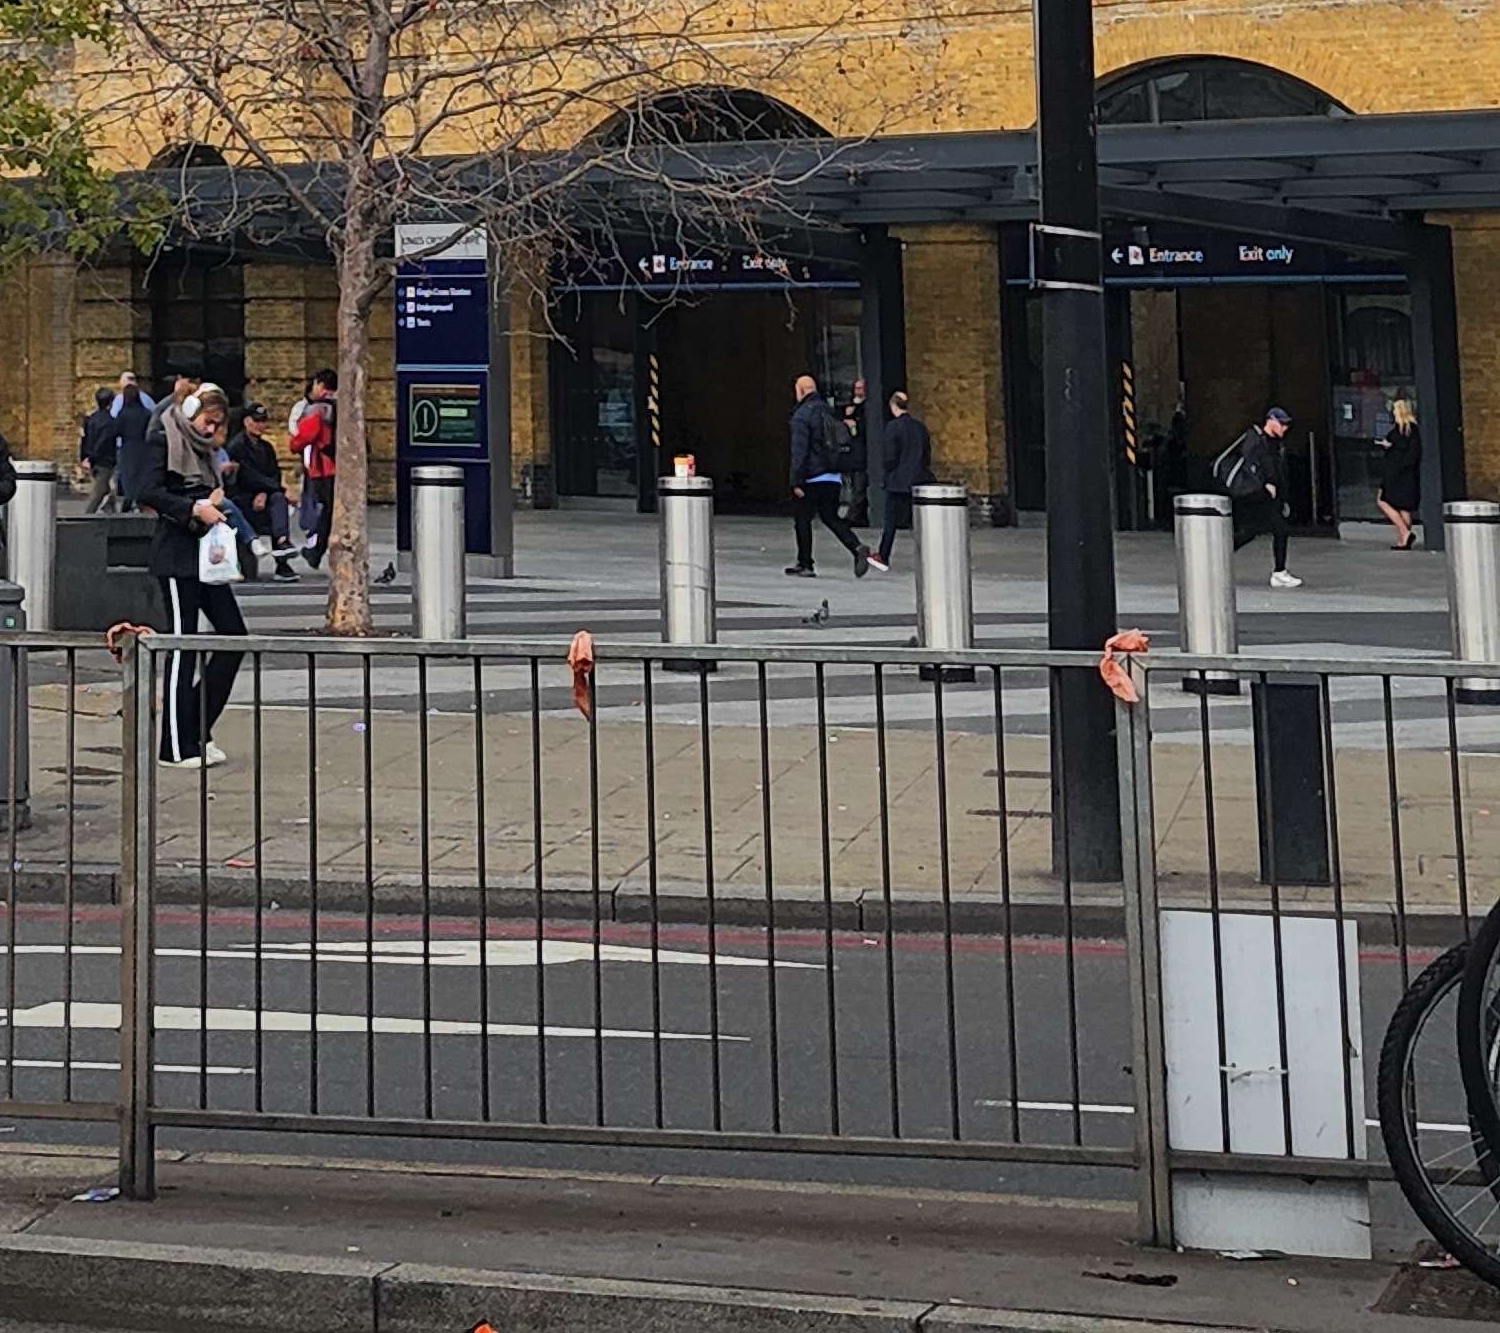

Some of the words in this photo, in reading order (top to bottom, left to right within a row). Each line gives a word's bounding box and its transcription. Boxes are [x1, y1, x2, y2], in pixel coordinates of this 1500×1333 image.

[1149, 247, 1204, 264] Entrance
[1238, 245, 1264, 262] Exit
[1265, 244, 1294, 265] only
